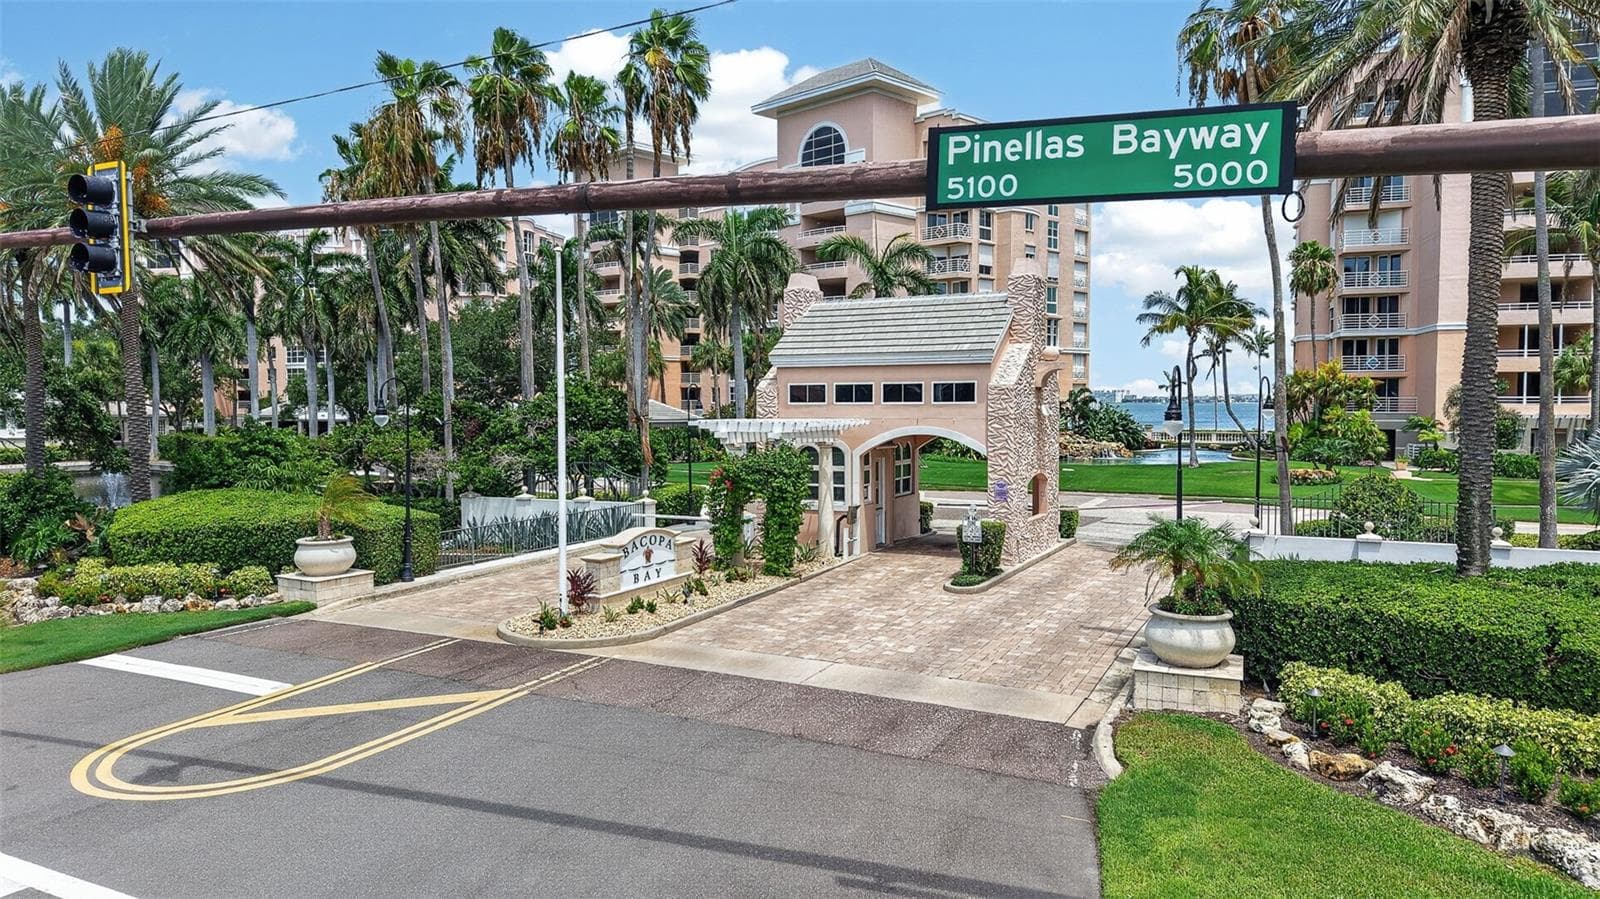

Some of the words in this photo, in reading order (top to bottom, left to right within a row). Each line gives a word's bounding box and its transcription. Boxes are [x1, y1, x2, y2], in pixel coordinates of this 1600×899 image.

[948, 129, 1084, 165] Pinellas
[1112, 121, 1269, 159] Bayway
[1173, 159, 1268, 188] 5000
[947, 174, 1018, 199] 5100
[622, 534, 672, 559] BACOPA
[633, 567, 662, 584] BAY
